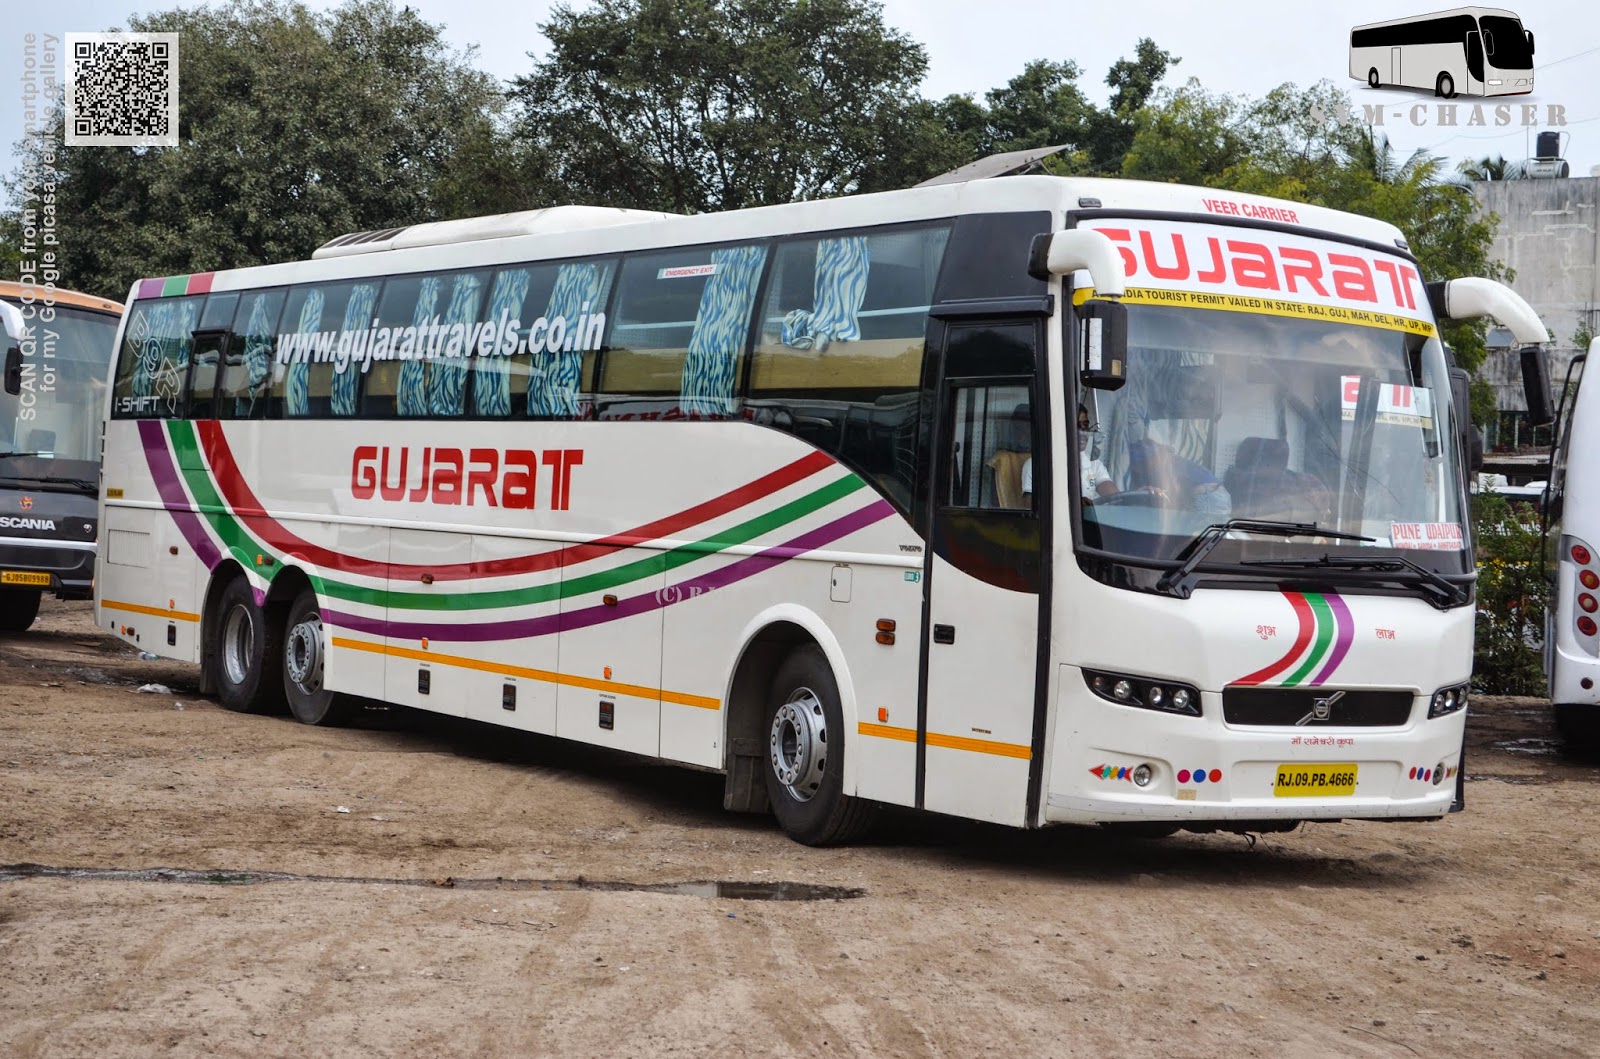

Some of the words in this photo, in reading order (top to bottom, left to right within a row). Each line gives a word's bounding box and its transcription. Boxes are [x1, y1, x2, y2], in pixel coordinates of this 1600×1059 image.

[1202, 199, 1240, 216] VEER
[1241, 203, 1300, 224] CARRIER
[665, 269, 699, 277] EMERGENCY
[1123, 290, 1142, 299] DIA
[1145, 290, 1187, 302] TOURIST
[1190, 294, 1225, 305] PERMIT
[1228, 297, 1261, 308] VAILED
[1264, 301, 1273, 309] IN
[1276, 302, 1306, 313] STATE:
[1329, 309, 1350, 319] GUJ,
[1351, 311, 1373, 323] MAH,
[1374, 314, 1393, 326] DEL,
[1393, 317, 1408, 329] HR,
[1408, 321, 1422, 332] UP,
[276, 302, 606, 374] www.gujarattravels.co.in
[114, 396, 160, 412] I-SHIFT
[0, 516, 56, 531] SCANIA
[1392, 524, 1421, 540] PUNE
[1425, 523, 1462, 540] UDAIPUR
[1256, 625, 1276, 640] शुभ
[1375, 628, 1396, 640] लाभ
[1277, 772, 1355, 787] RJ.09.PB.4666
